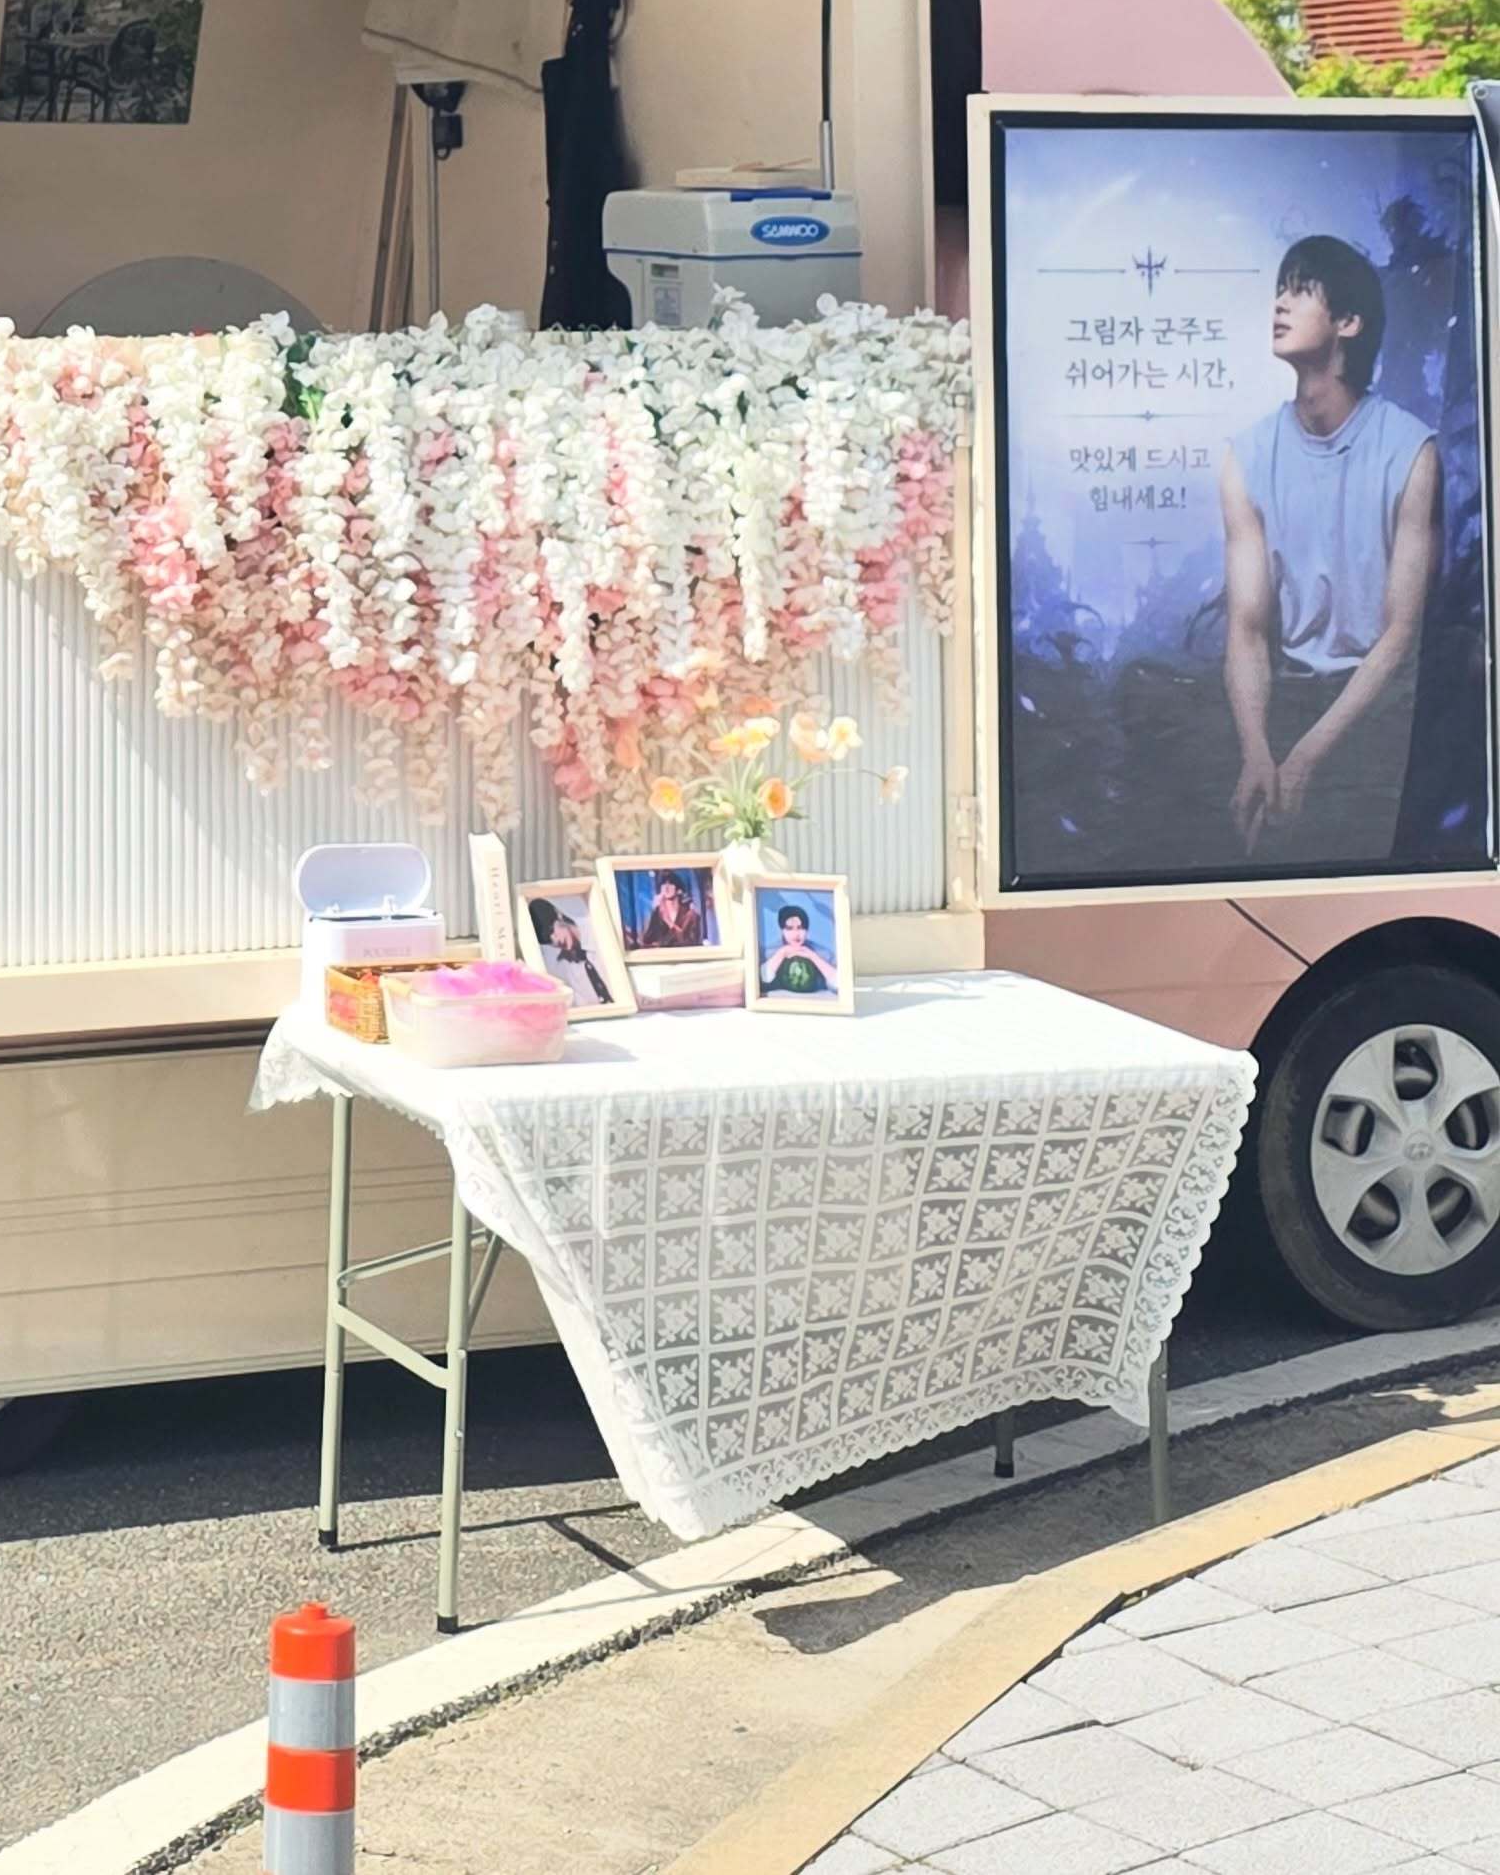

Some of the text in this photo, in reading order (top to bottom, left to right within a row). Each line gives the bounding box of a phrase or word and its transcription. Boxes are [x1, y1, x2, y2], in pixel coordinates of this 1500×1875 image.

[1065, 315, 1229, 347] 그림자 군주도
[1065, 358, 1235, 390] 쉬어가는 시간,
[1069, 444, 1211, 474] 맛있게 드시고
[1089, 484, 1187, 513] 힘내세요!
